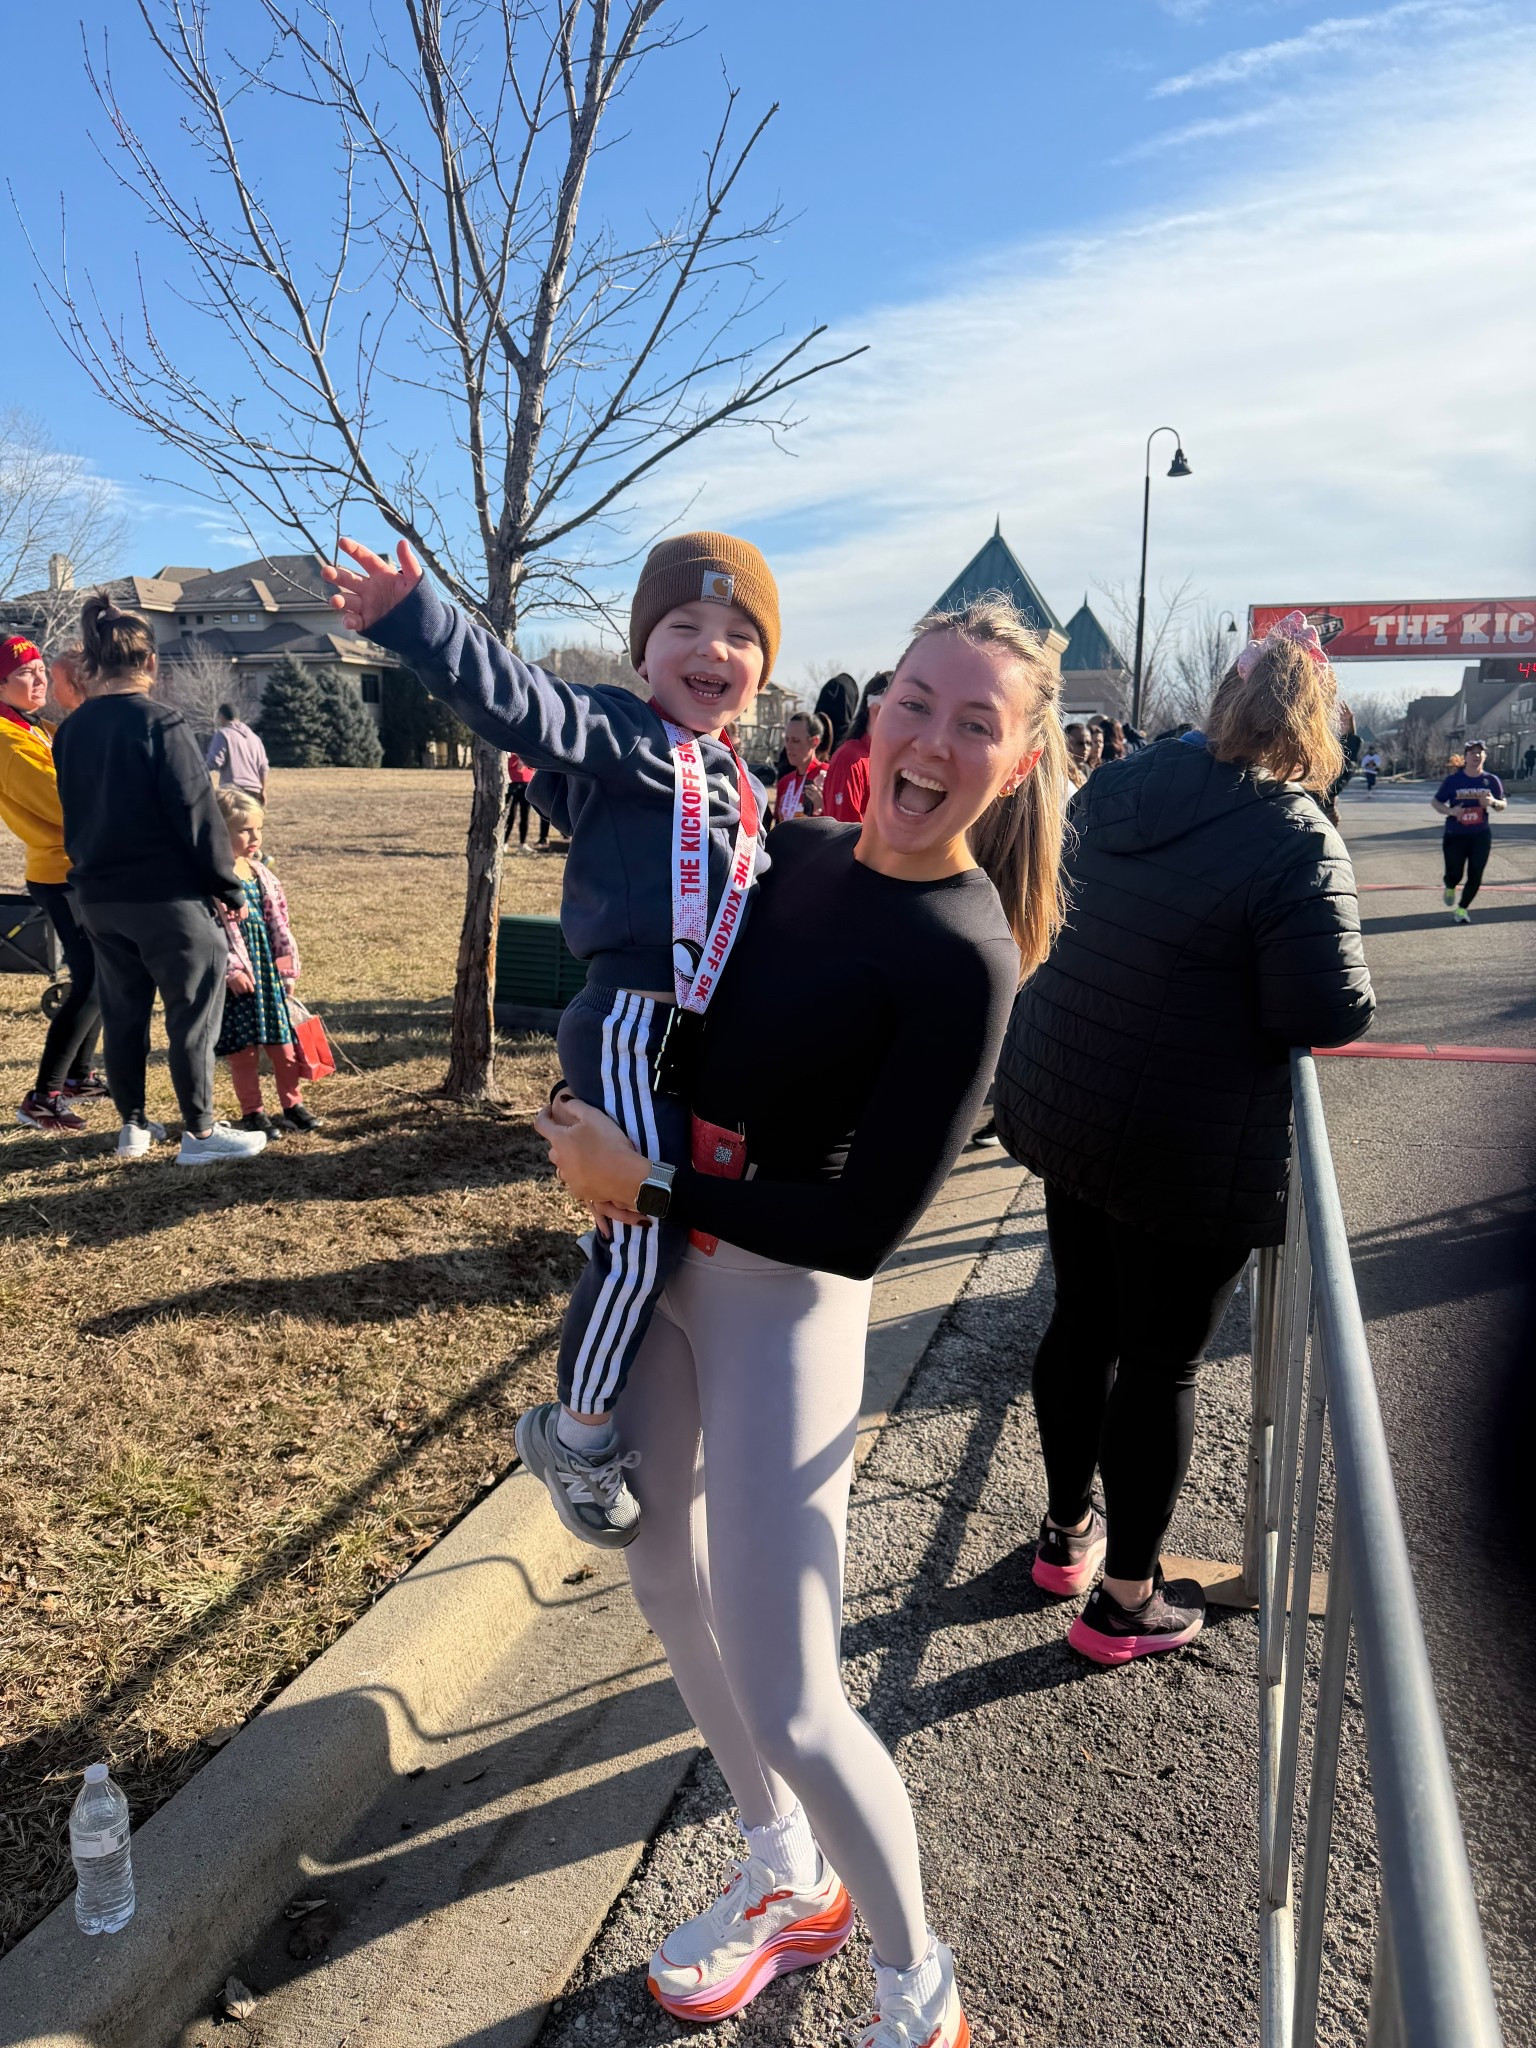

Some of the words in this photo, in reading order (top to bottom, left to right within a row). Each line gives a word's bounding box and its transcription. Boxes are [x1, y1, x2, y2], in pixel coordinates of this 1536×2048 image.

[1369, 614, 1449, 645] THE
[1460, 612, 1536, 644] KIC
[681, 768, 701, 852] KICKOFF
[680, 859, 700, 896] THE
[733, 852, 751, 889] THE
[707, 889, 743, 972] KICKOFF
[695, 973, 713, 1001] 5K
